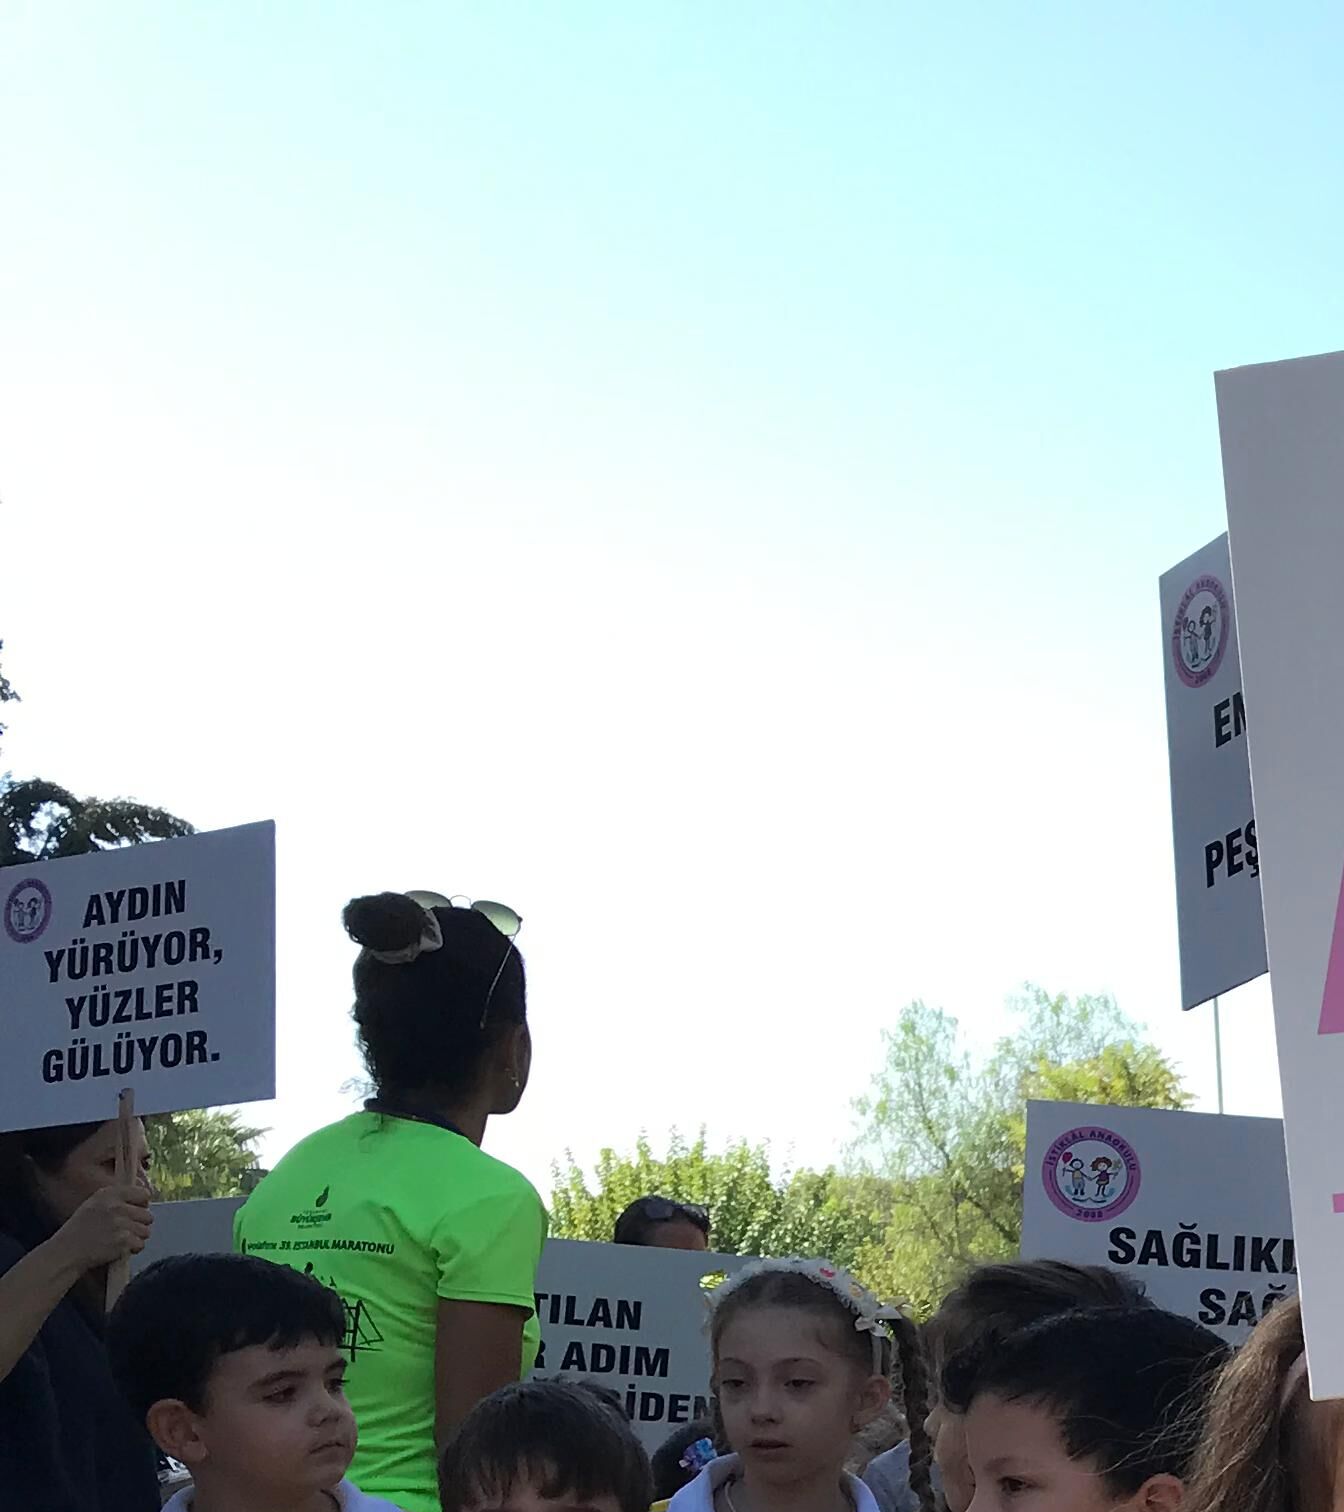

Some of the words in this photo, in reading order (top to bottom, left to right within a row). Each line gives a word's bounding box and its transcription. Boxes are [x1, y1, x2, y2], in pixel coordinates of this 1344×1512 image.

[82, 880, 187, 929] AYDIN
[44, 927, 223, 984] YÜRÜYOR,
[65, 980, 199, 1030] YÜZLER
[42, 1030, 221, 1084] GÜLÜYOR.
[331, 1239, 395, 1254] MARATONU
[560, 1341, 670, 1378] ADIM
